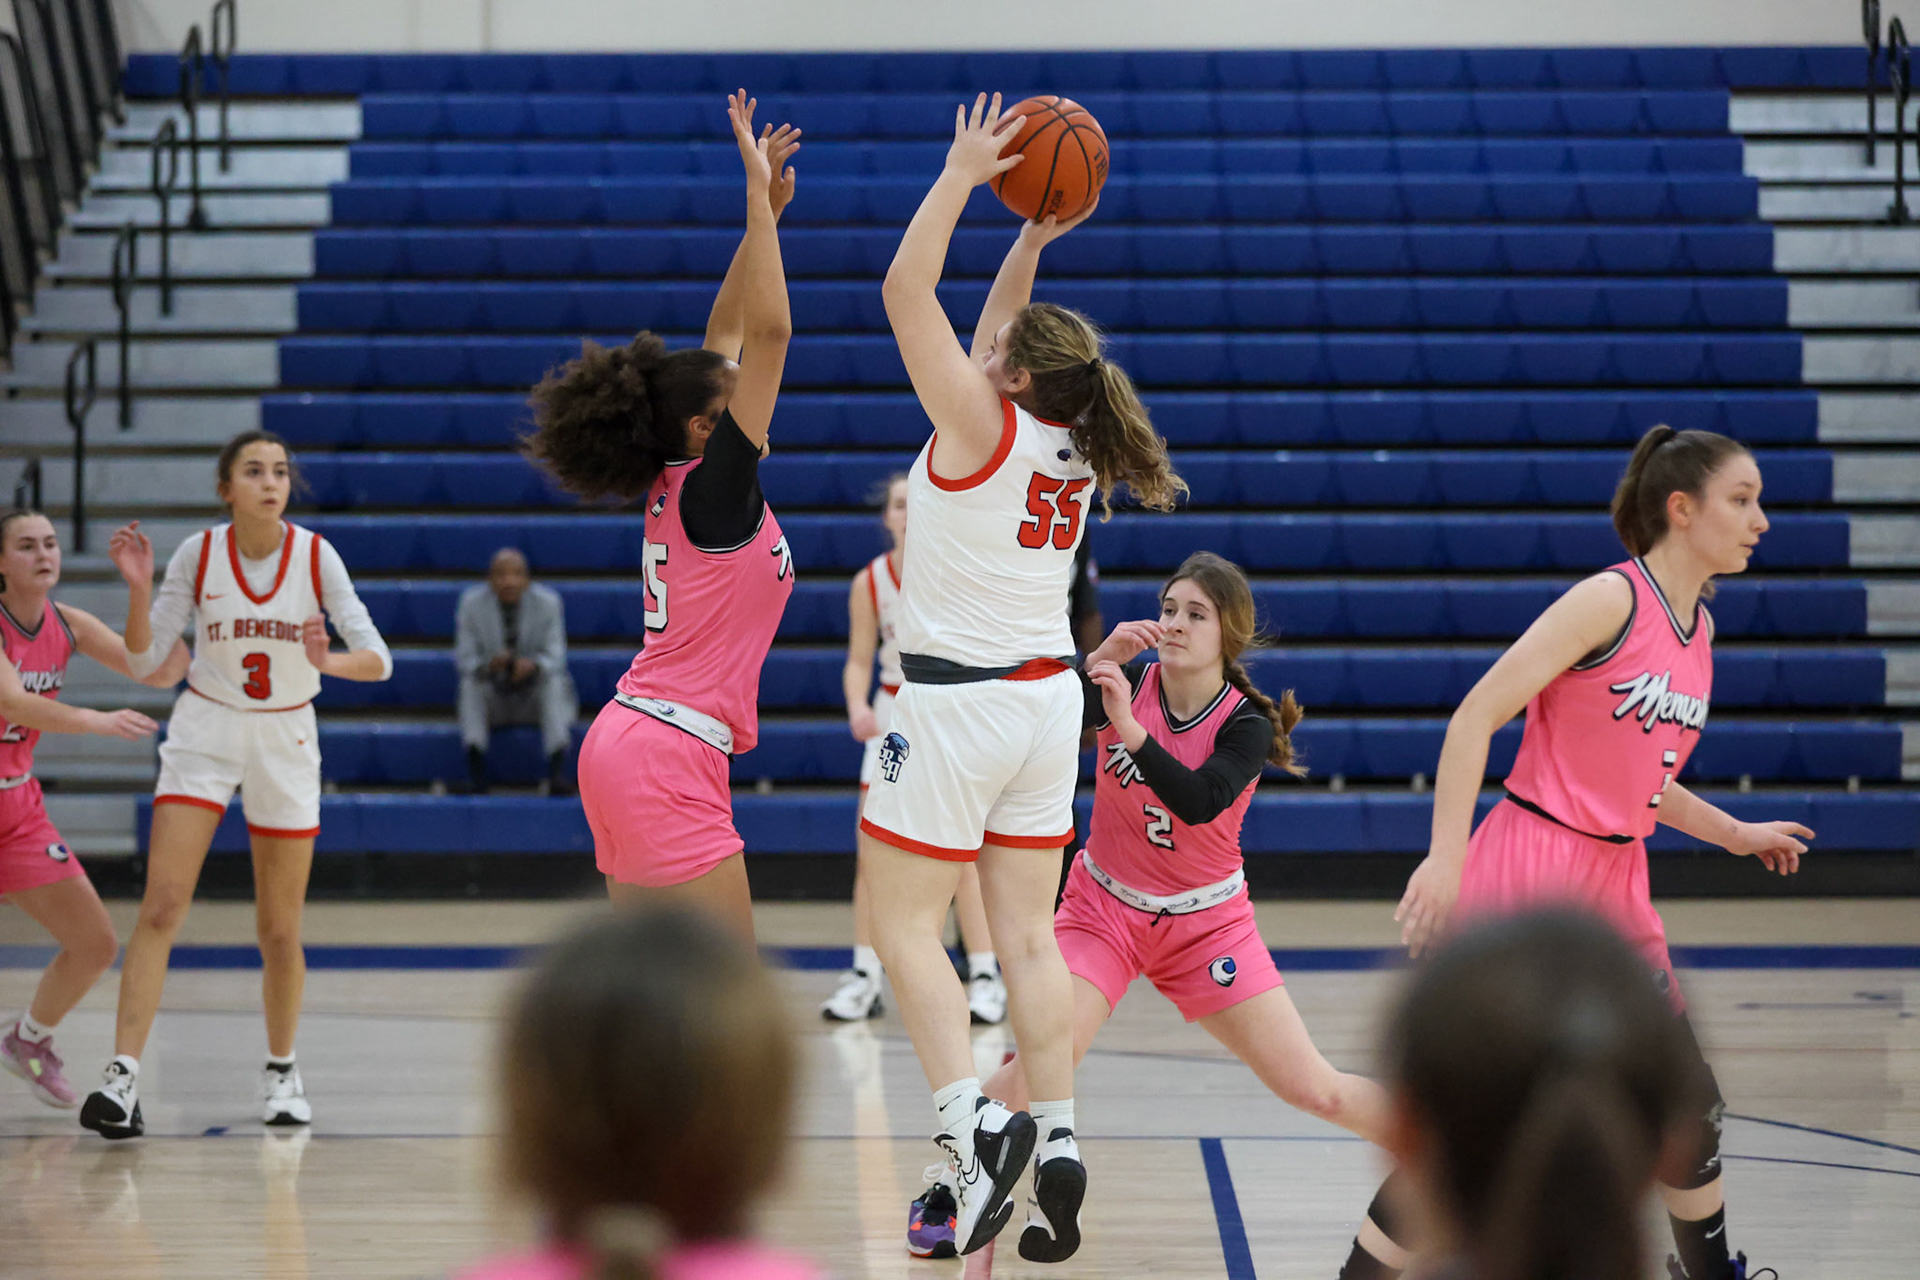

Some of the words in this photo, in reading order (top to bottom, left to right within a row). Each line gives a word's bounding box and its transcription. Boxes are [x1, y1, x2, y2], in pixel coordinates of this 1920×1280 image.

[1016, 471, 1091, 550] 55
[234, 618, 303, 643] BENEDIC
[242, 652, 272, 701] 3
[1143, 803, 1175, 851] 2
